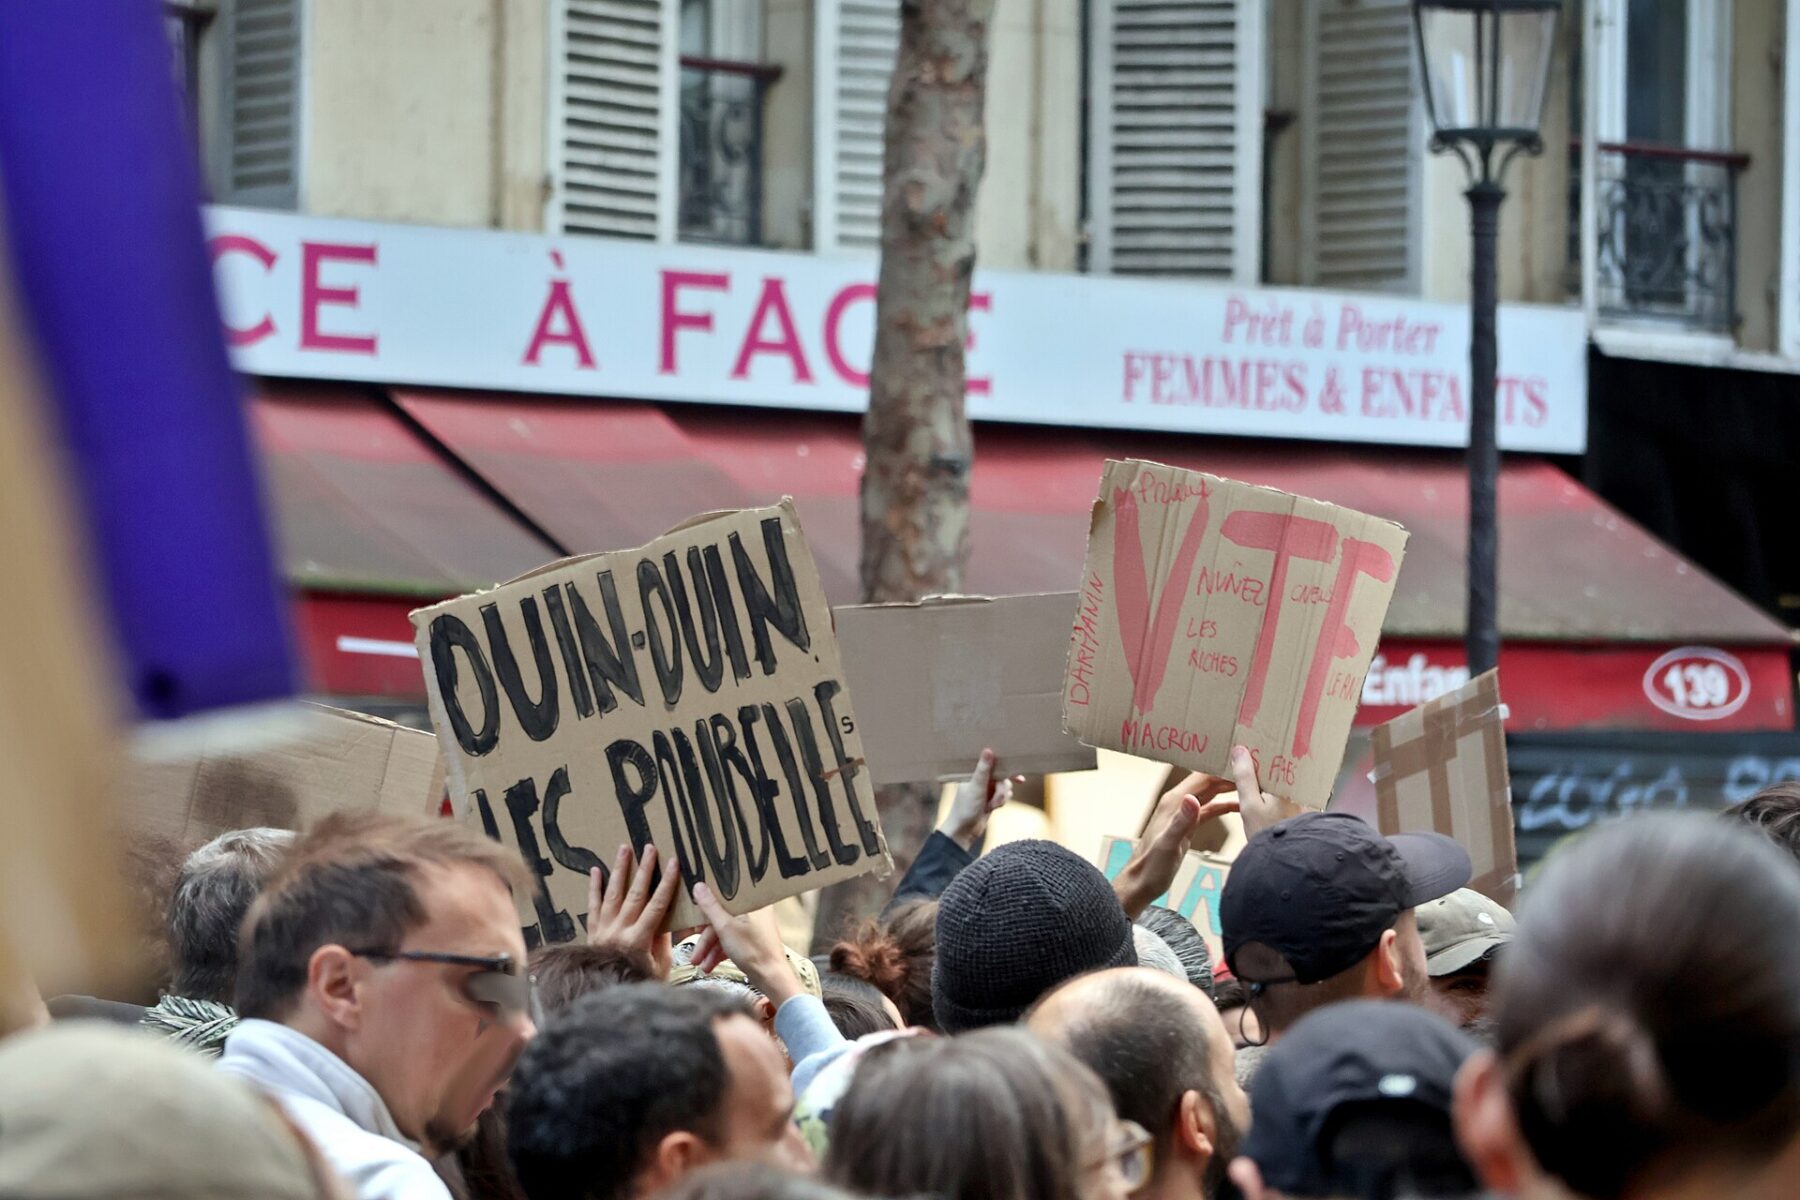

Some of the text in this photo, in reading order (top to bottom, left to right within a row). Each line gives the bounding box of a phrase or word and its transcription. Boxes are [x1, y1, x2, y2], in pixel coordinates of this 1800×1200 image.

[522, 250, 597, 370] À
[659, 268, 993, 397] FAC
[1303, 298, 1325, 349] à
[1337, 302, 1442, 355] Porter
[1123, 351, 1549, 428] FEMMES & ENFATS
[1186, 617, 1217, 638] LES
[1188, 650, 1238, 677] RICHES
[1663, 663, 1729, 707] 139
[1121, 719, 1208, 753] MACRON
